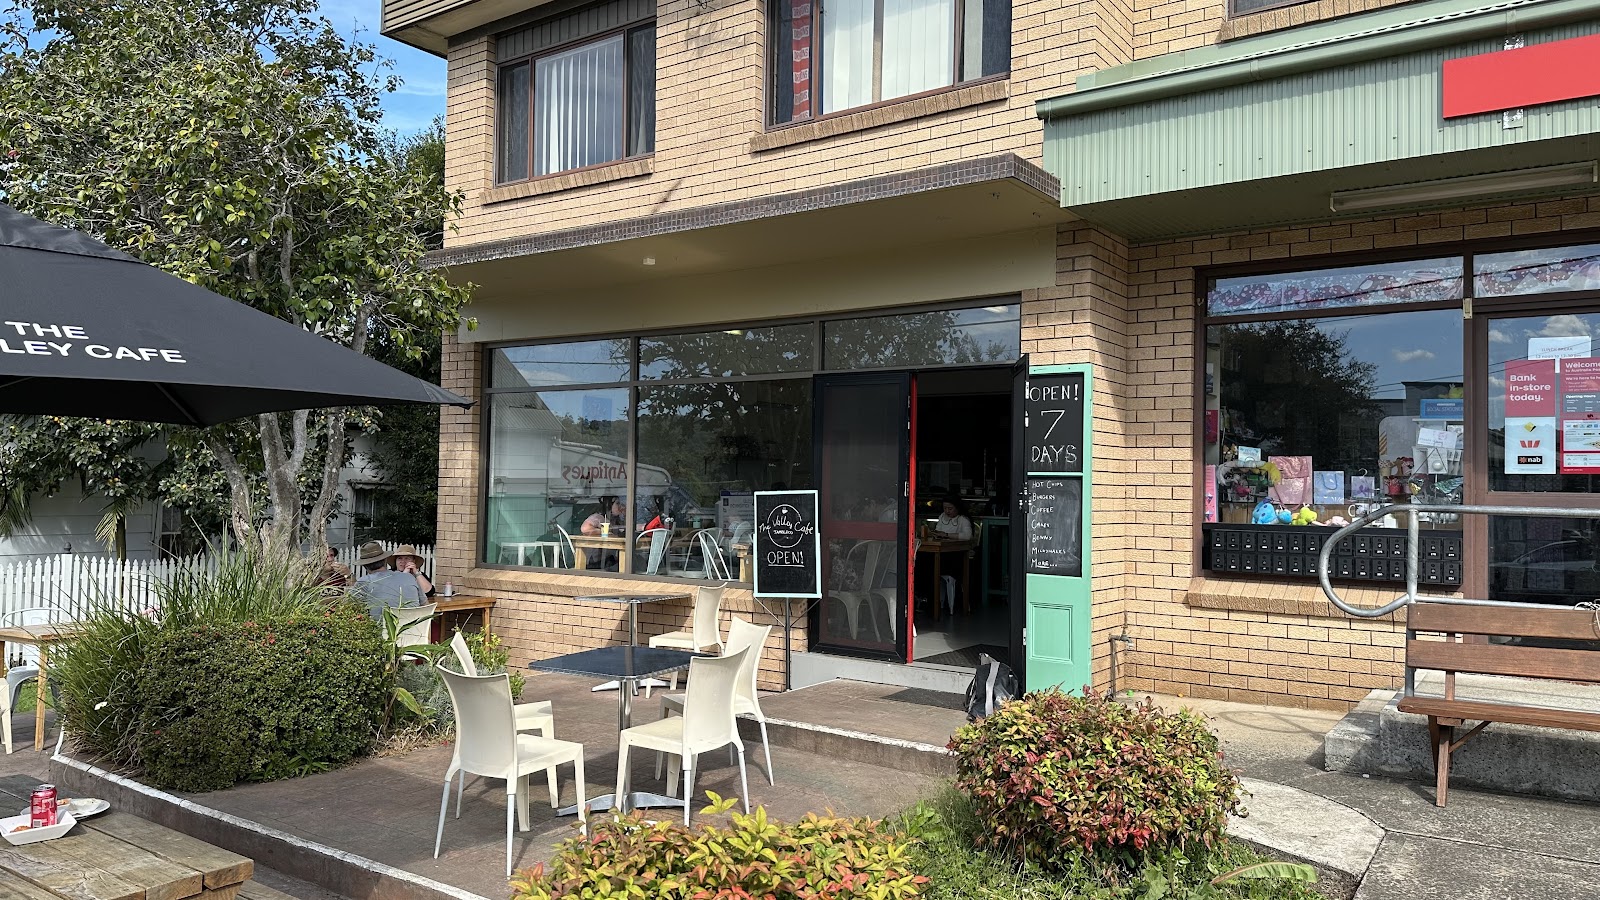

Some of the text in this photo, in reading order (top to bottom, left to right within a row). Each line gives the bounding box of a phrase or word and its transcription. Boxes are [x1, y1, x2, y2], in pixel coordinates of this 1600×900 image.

[4, 320, 89, 340] THE
[84, 344, 187, 364] CAFE
[1509, 374, 1537, 382] Bank
[1029, 383, 1079, 401] OPEN!
[1509, 393, 1544, 402] today.
[1040, 409, 1066, 440] 7
[1031, 444, 1078, 463] DAYS
[1031, 481, 1044, 489] HOT
[767, 551, 804, 565] OPEN!
